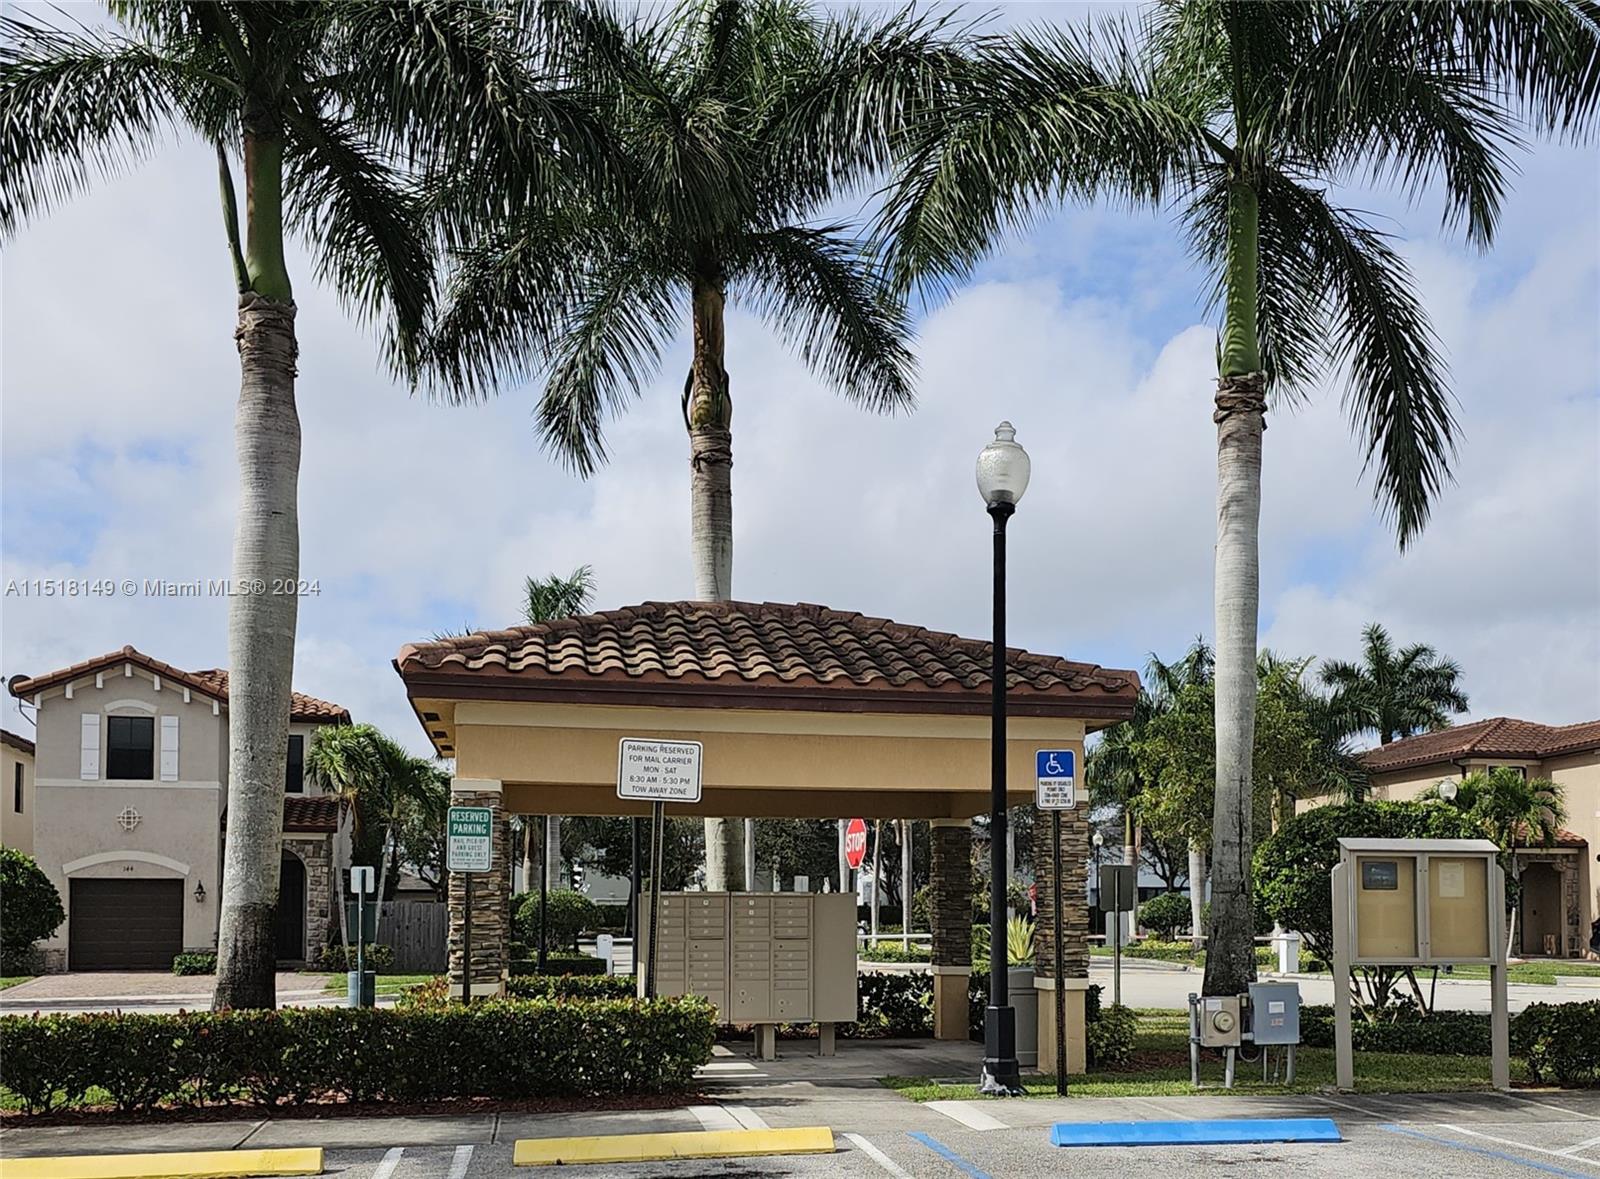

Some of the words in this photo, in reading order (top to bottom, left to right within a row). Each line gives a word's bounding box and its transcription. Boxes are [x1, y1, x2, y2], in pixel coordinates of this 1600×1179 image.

[627, 744, 658, 753] PARKING
[659, 746, 695, 755] RESERVED
[662, 757, 692, 765] CARRIER
[451, 811, 489, 822] RESERVED
[452, 824, 487, 834] PARKING
[847, 832, 865, 852] STOP
